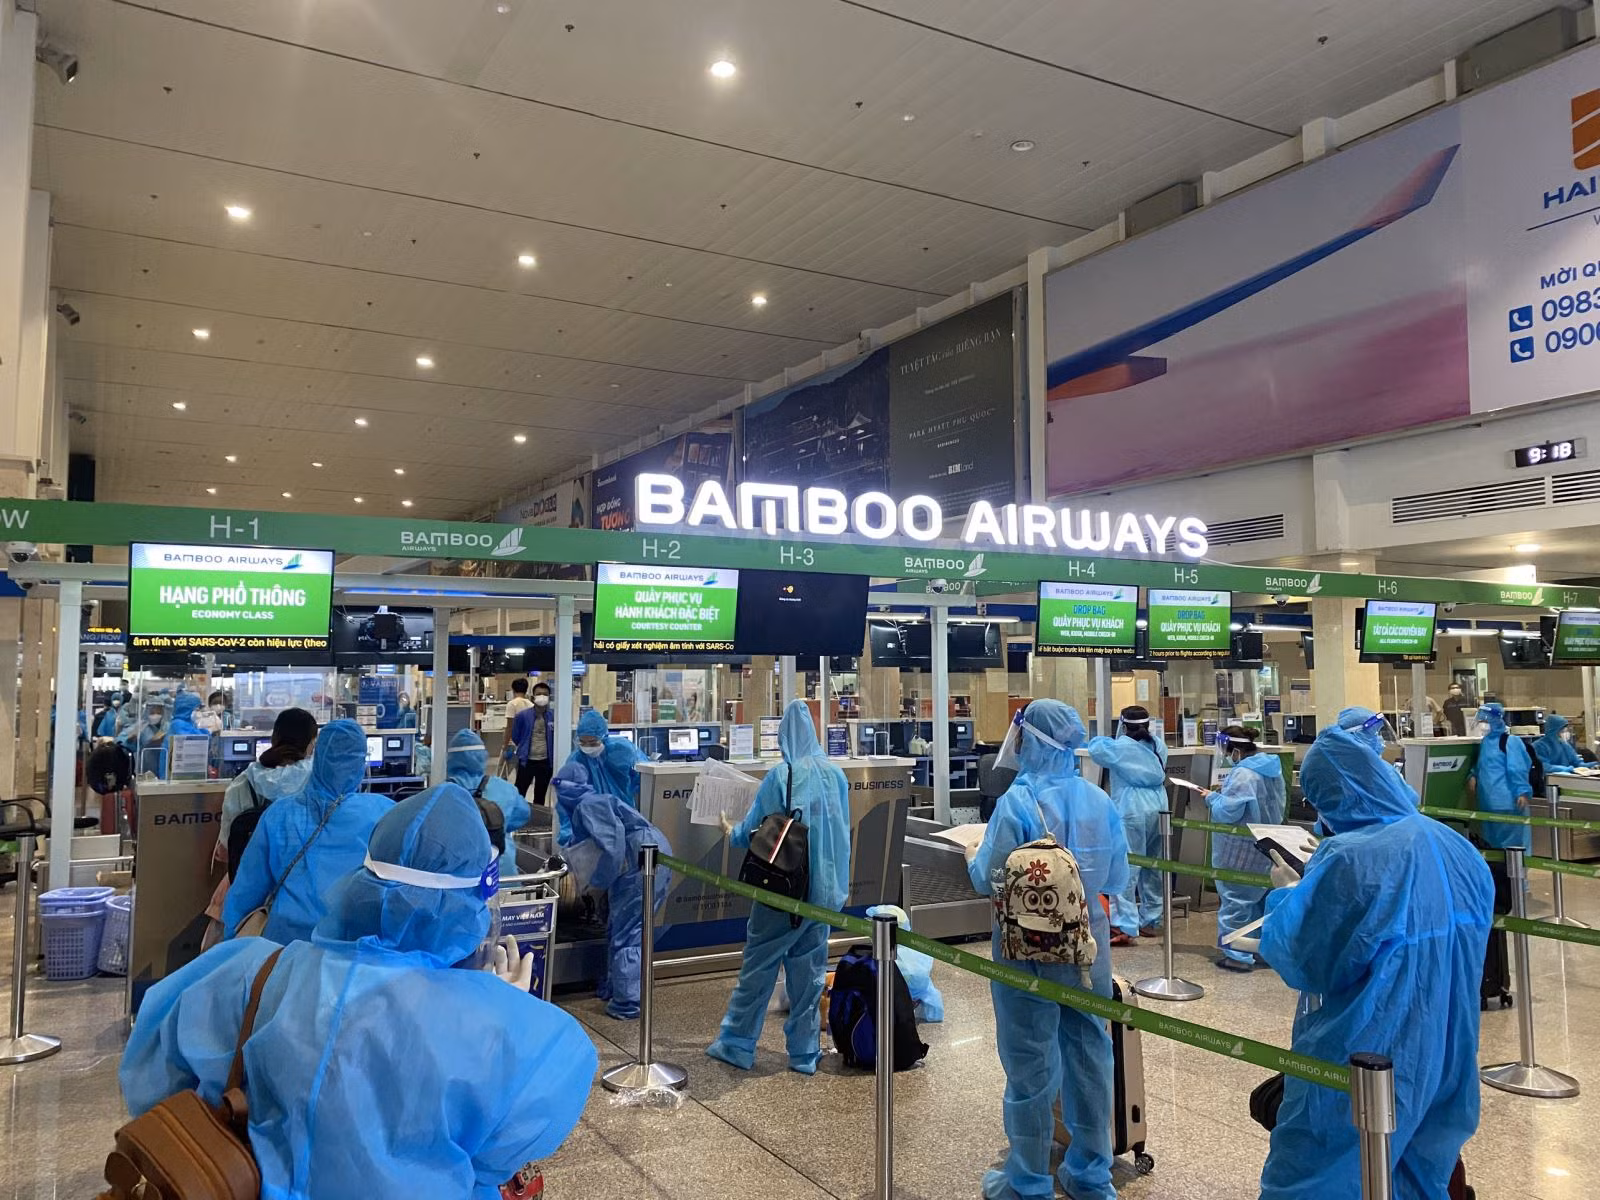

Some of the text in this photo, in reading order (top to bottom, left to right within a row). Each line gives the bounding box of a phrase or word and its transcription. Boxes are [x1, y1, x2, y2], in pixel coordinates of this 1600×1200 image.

[1540, 267, 1577, 289] MỜI
[1528, 442, 1572, 464] 9:18
[635, 473, 1209, 557] BAMBOO AIRWAYS
[210, 515, 259, 540] H-1
[401, 531, 493, 548] BAMBOO
[642, 538, 681, 560] H-2
[780, 546, 815, 566] H-3
[164, 553, 284, 565] BAMBOO AIRWAYS
[904, 557, 965, 570] BAMBOO
[620, 571, 704, 582] BAMBOO AIRWAYS
[1068, 560, 1096, 578] H-4
[1174, 567, 1199, 585] H-5
[1265, 576, 1308, 588] BAMBOO
[1378, 580, 1398, 595] H-6
[159, 580, 307, 608] HẠNG PHỔ THÔNG
[1500, 591, 1533, 600] BAMBOO
[1563, 591, 1579, 603] H-7
[191, 609, 275, 619] ECONOMY CLASS
[151, 636, 171, 647] tính
[188, 637, 246, 647] SARS-CoV-2
[247, 637, 265, 647] còn
[266, 637, 286, 649] hiệu
[303, 638, 328, 649] (theo
[854, 780, 904, 791] BUSINESS
[1061, 992, 1121, 1017] BAMBOO AIRWAYS
[1158, 1022, 1232, 1050] BAMBOO AIRWAYS
[1278, 1056, 1321, 1076] BAMBOO
